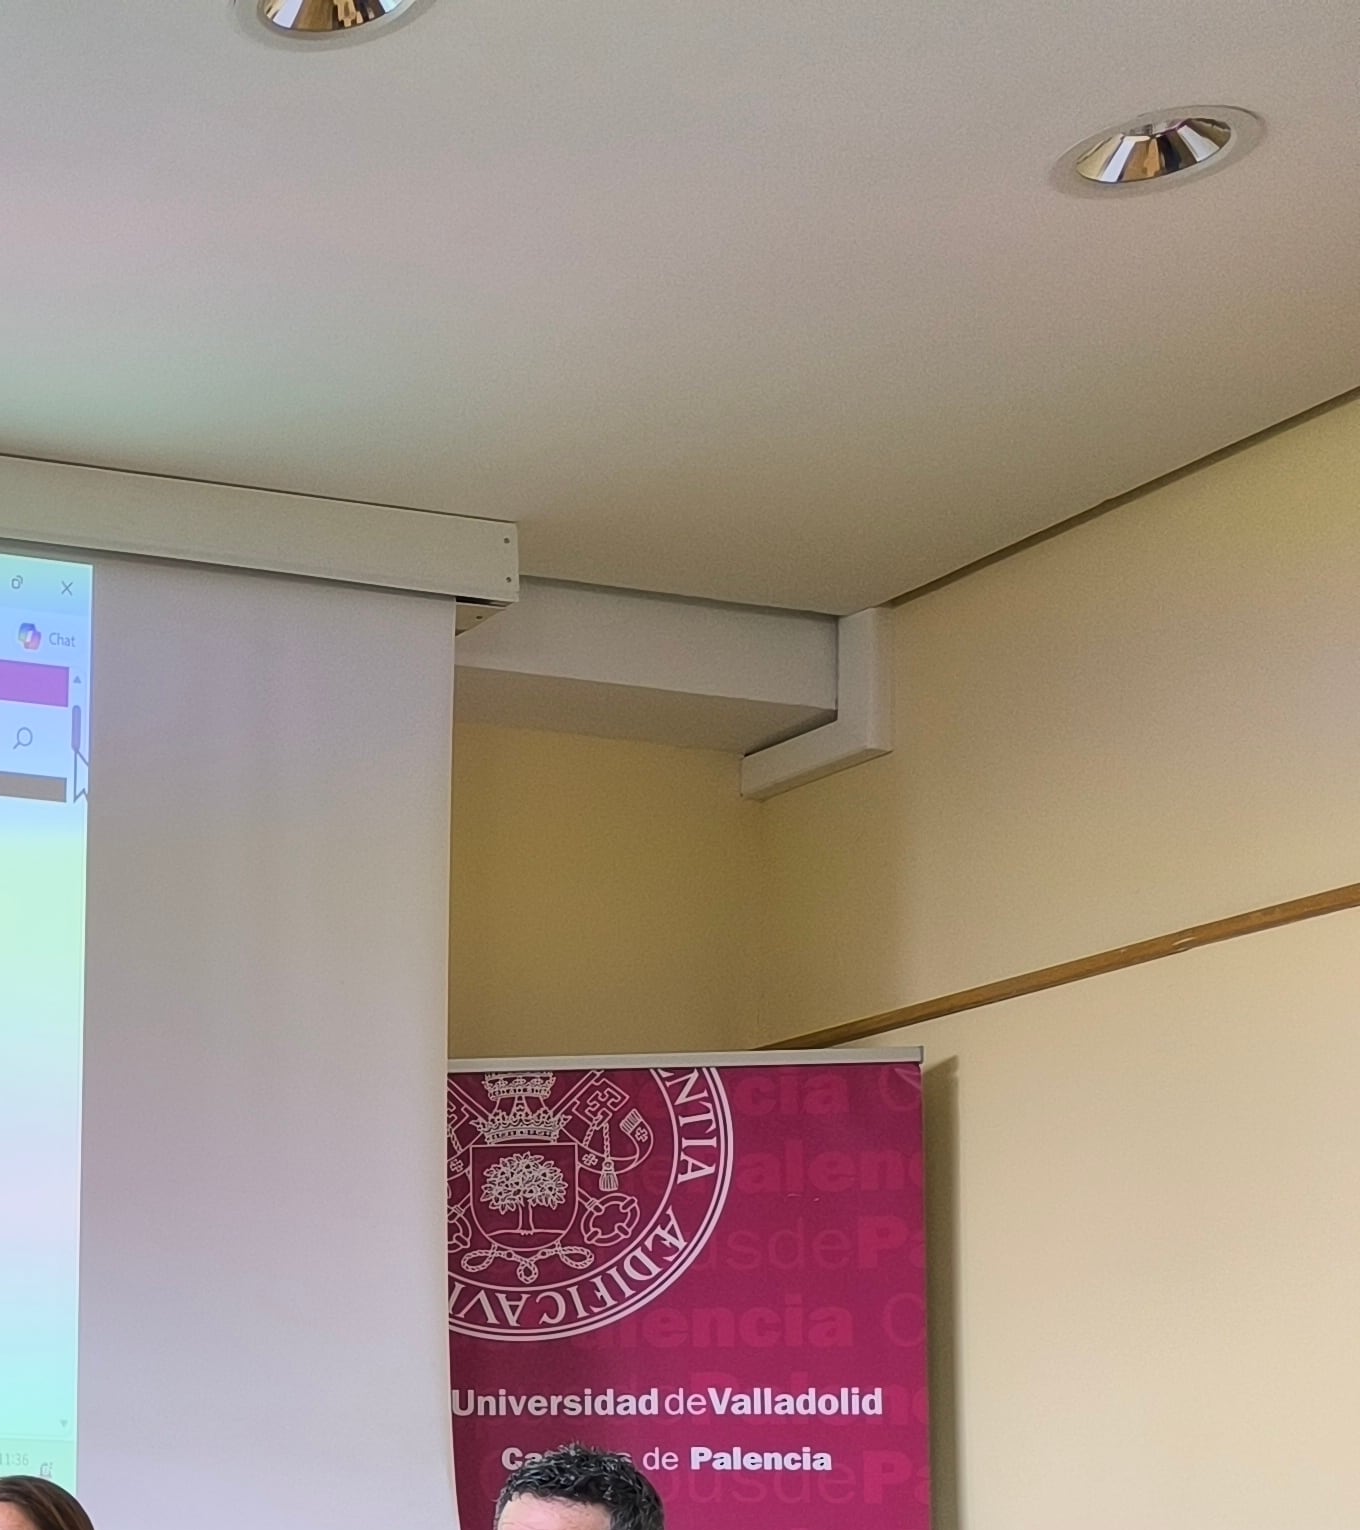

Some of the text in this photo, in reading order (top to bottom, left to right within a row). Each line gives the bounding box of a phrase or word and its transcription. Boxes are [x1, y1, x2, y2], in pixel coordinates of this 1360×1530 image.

[48, 630, 76, 649] Chat
[452, 1388, 659, 1417] Universidad
[642, 1446, 679, 1471] de
[689, 1445, 832, 1471] Palencia
